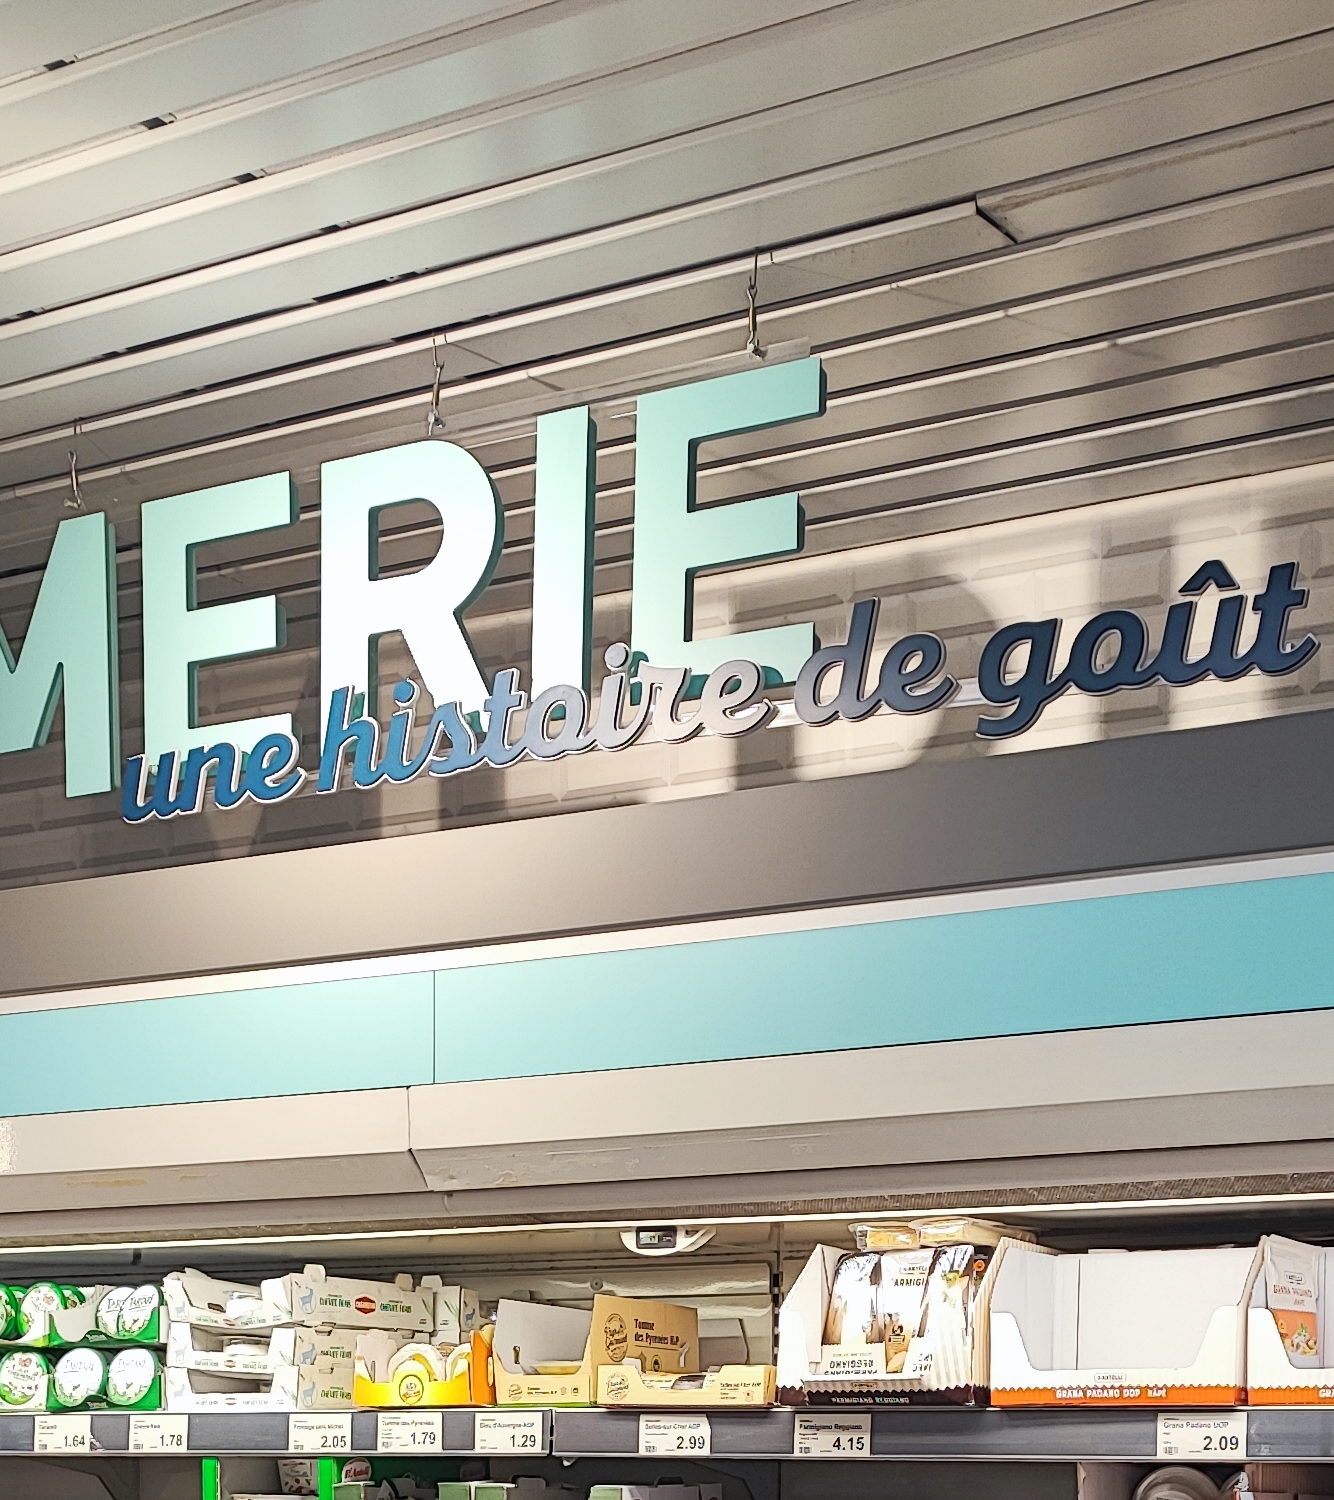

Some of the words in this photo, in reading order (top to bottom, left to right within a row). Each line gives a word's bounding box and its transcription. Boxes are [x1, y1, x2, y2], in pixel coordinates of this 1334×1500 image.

[120, 727, 302, 825] une
[319, 640, 768, 792] histoire
[794, 597, 952, 723] de
[970, 558, 1323, 740] goût
[64, 1435, 85, 1447] 1.64
[160, 1435, 183, 1447] 1.78
[321, 1436, 347, 1449] 2.05
[410, 1430, 436, 1446] 1.79
[510, 1433, 536, 1448] 1.29
[677, 1436, 705, 1449] 2.99
[833, 1436, 865, 1452] 4.15
[1203, 1436, 1239, 1451] 2.09
